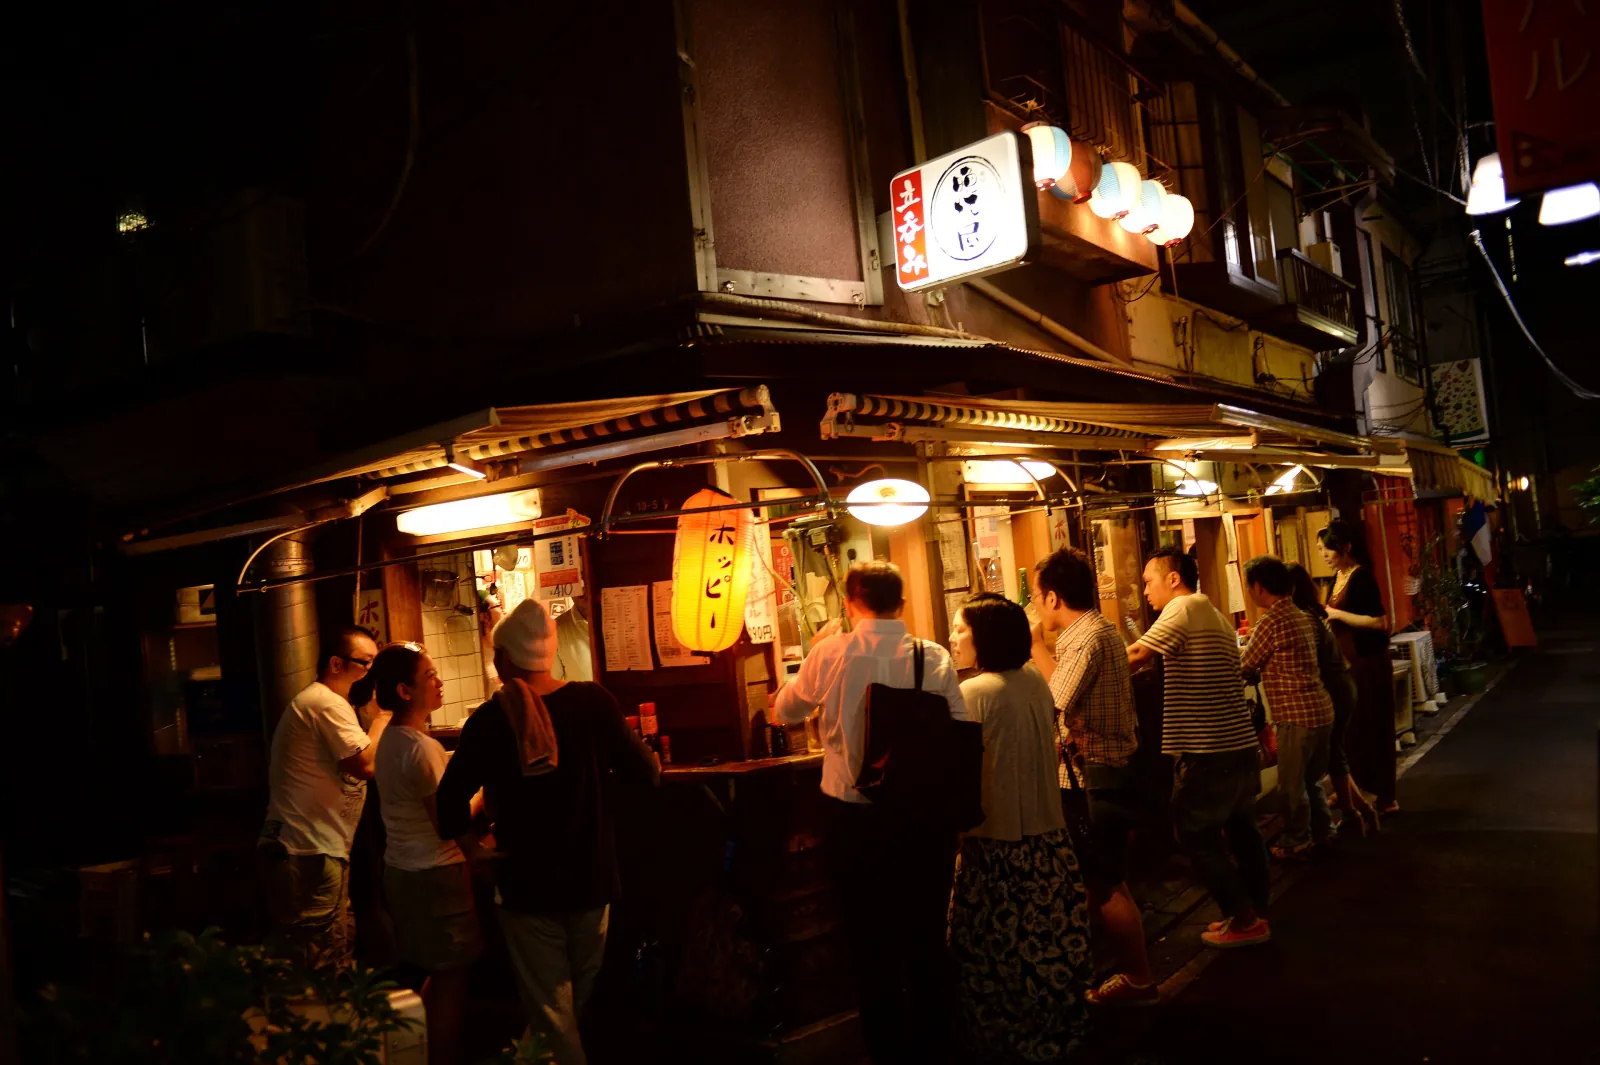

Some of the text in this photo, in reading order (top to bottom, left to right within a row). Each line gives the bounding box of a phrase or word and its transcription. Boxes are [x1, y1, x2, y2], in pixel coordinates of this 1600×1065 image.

[895, 179, 928, 276] 立呑み
[705, 520, 736, 630] ホッピー
